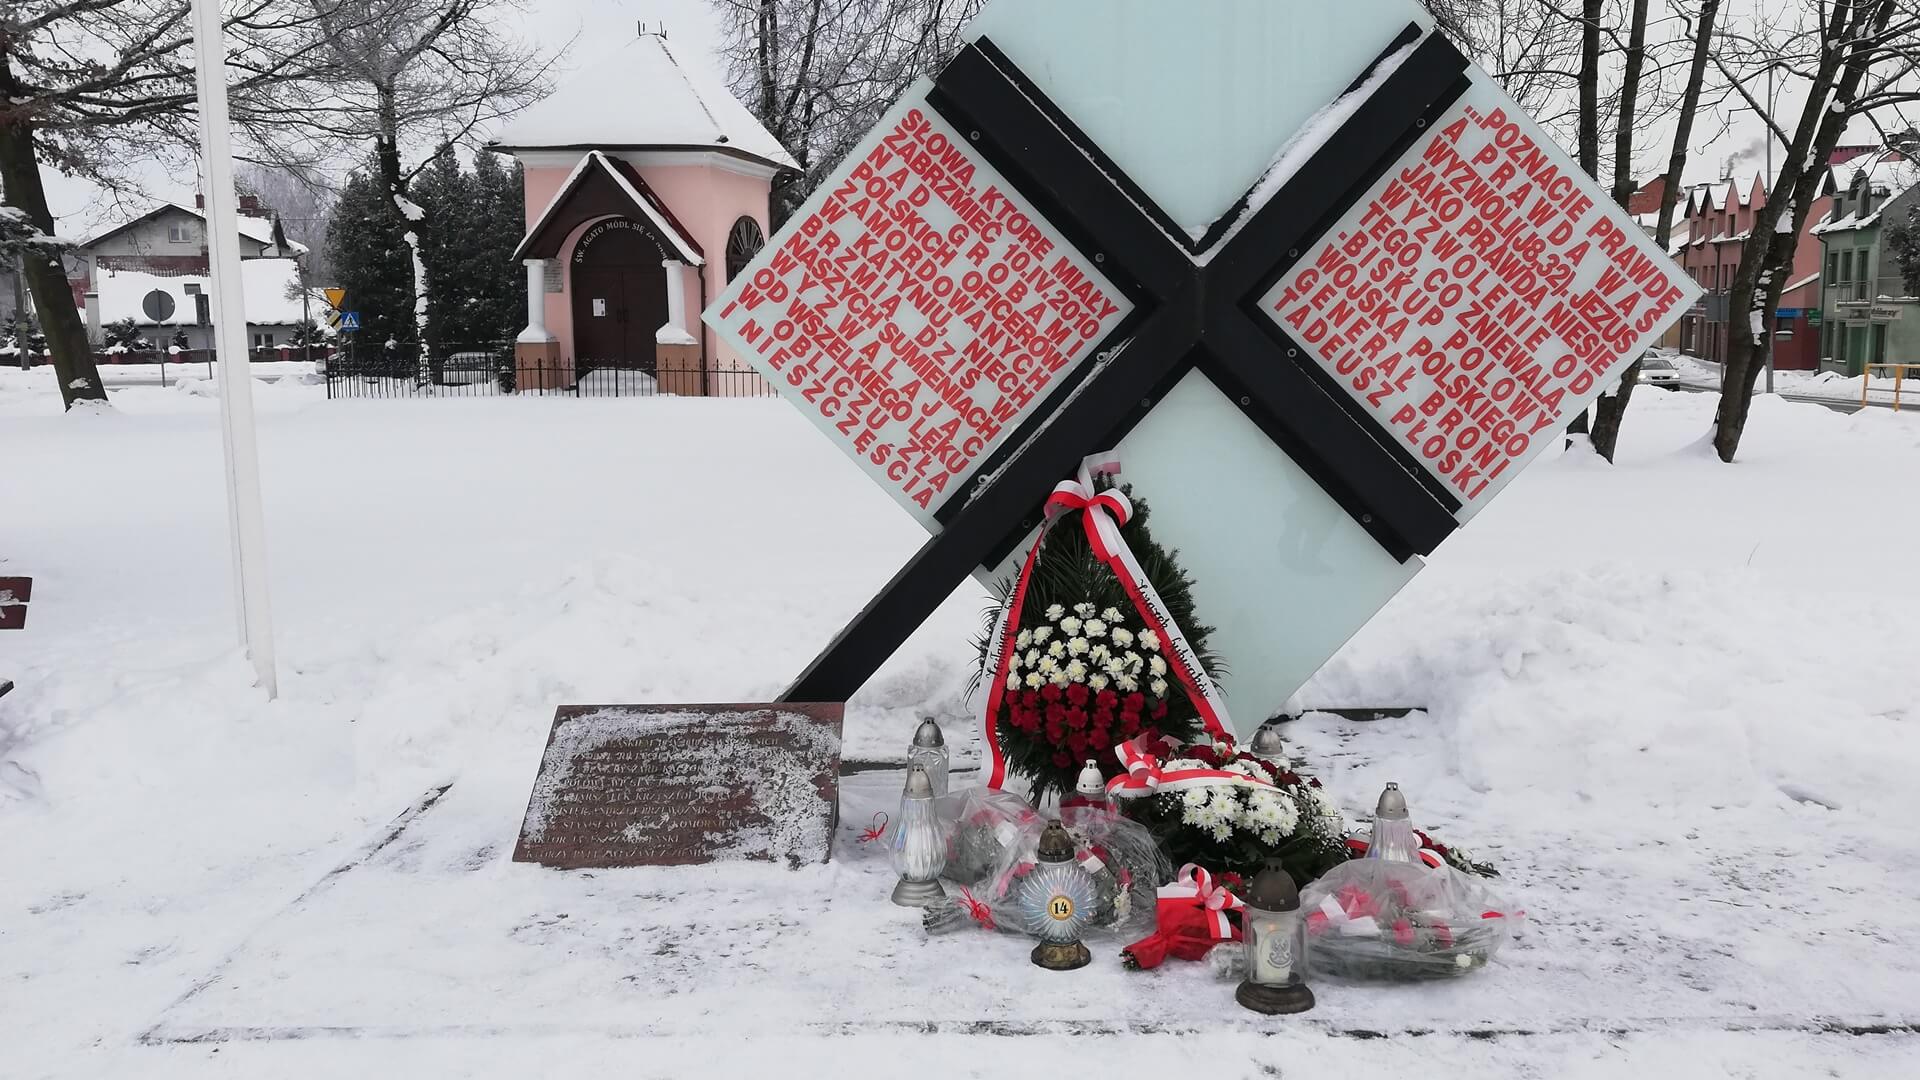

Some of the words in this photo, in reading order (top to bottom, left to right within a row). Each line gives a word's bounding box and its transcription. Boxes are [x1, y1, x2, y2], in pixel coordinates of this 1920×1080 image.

[583, 227, 604, 248] AGATO
[606, 219, 630, 230] MÓDL
[632, 223, 646, 235] SIĘ
[798, 214, 901, 320] BRZMIĄ
[914, 325, 981, 390] DZIŚ
[992, 397, 1017, 423] W
[819, 196, 846, 224] W
[852, 233, 953, 335] KATYNIU,
[963, 339, 1034, 408] NIECH
[834, 179, 1051, 391] ZAMORDOWANYCH
[850, 162, 957, 268] POLSKICH
[960, 271, 1067, 375] OFICERÓW
[866, 145, 930, 208] NAD
[947, 224, 1084, 358] GROBAMI
[881, 127, 1002, 244] ZABRZMIEĆ
[1003, 244, 1099, 340] 10.IV.2010
[901, 109, 976, 193] SŁOWA,
[979, 187, 1053, 261] KTÓRE
[1051, 257, 1117, 320] MIAŁY
[1360, 201, 1422, 277] TEGO,
[1423, 269, 1463, 308] CO
[1381, 180, 1551, 352] WYZWOLENIE
[1552, 354, 1593, 394] OD
[1401, 164, 1464, 222] JAKO
[1457, 216, 1546, 310] PRAWDA
[1543, 304, 1616, 375] NIESIE
[1443, 120, 1466, 143] A
[1472, 145, 1589, 265] PRAWDA
[1596, 266, 1661, 333] WAS
[721, 302, 737, 318] I
[739, 320, 932, 508] NIESZCZĘŚCIA
[738, 283, 765, 311] W
[773, 320, 889, 430] OBLICZU
[899, 440, 948, 491] ZŁA
[754, 265, 789, 303] OD
[787, 299, 912, 421] WSZELKIEGO
[909, 416, 969, 475] LĘKU
[771, 250, 983, 457] WYZWALAJĄC
[785, 232, 883, 328] NASZYCH
[877, 322, 1000, 441] SUMIENIACH
[1276, 288, 1393, 407] TADEUSZ
[1392, 405, 1488, 497] PŁOSKI
[1296, 269, 1415, 391] GENERAŁ
[1420, 391, 1508, 478] BRONI
[1317, 245, 1408, 341] WOJSKA
[1407, 338, 1529, 457] POLSKIEGO
[1443, 329, 1552, 434] POLOWY
[1570, 291, 1638, 353] JEZUS
[1054, 900, 1068, 915] 14
